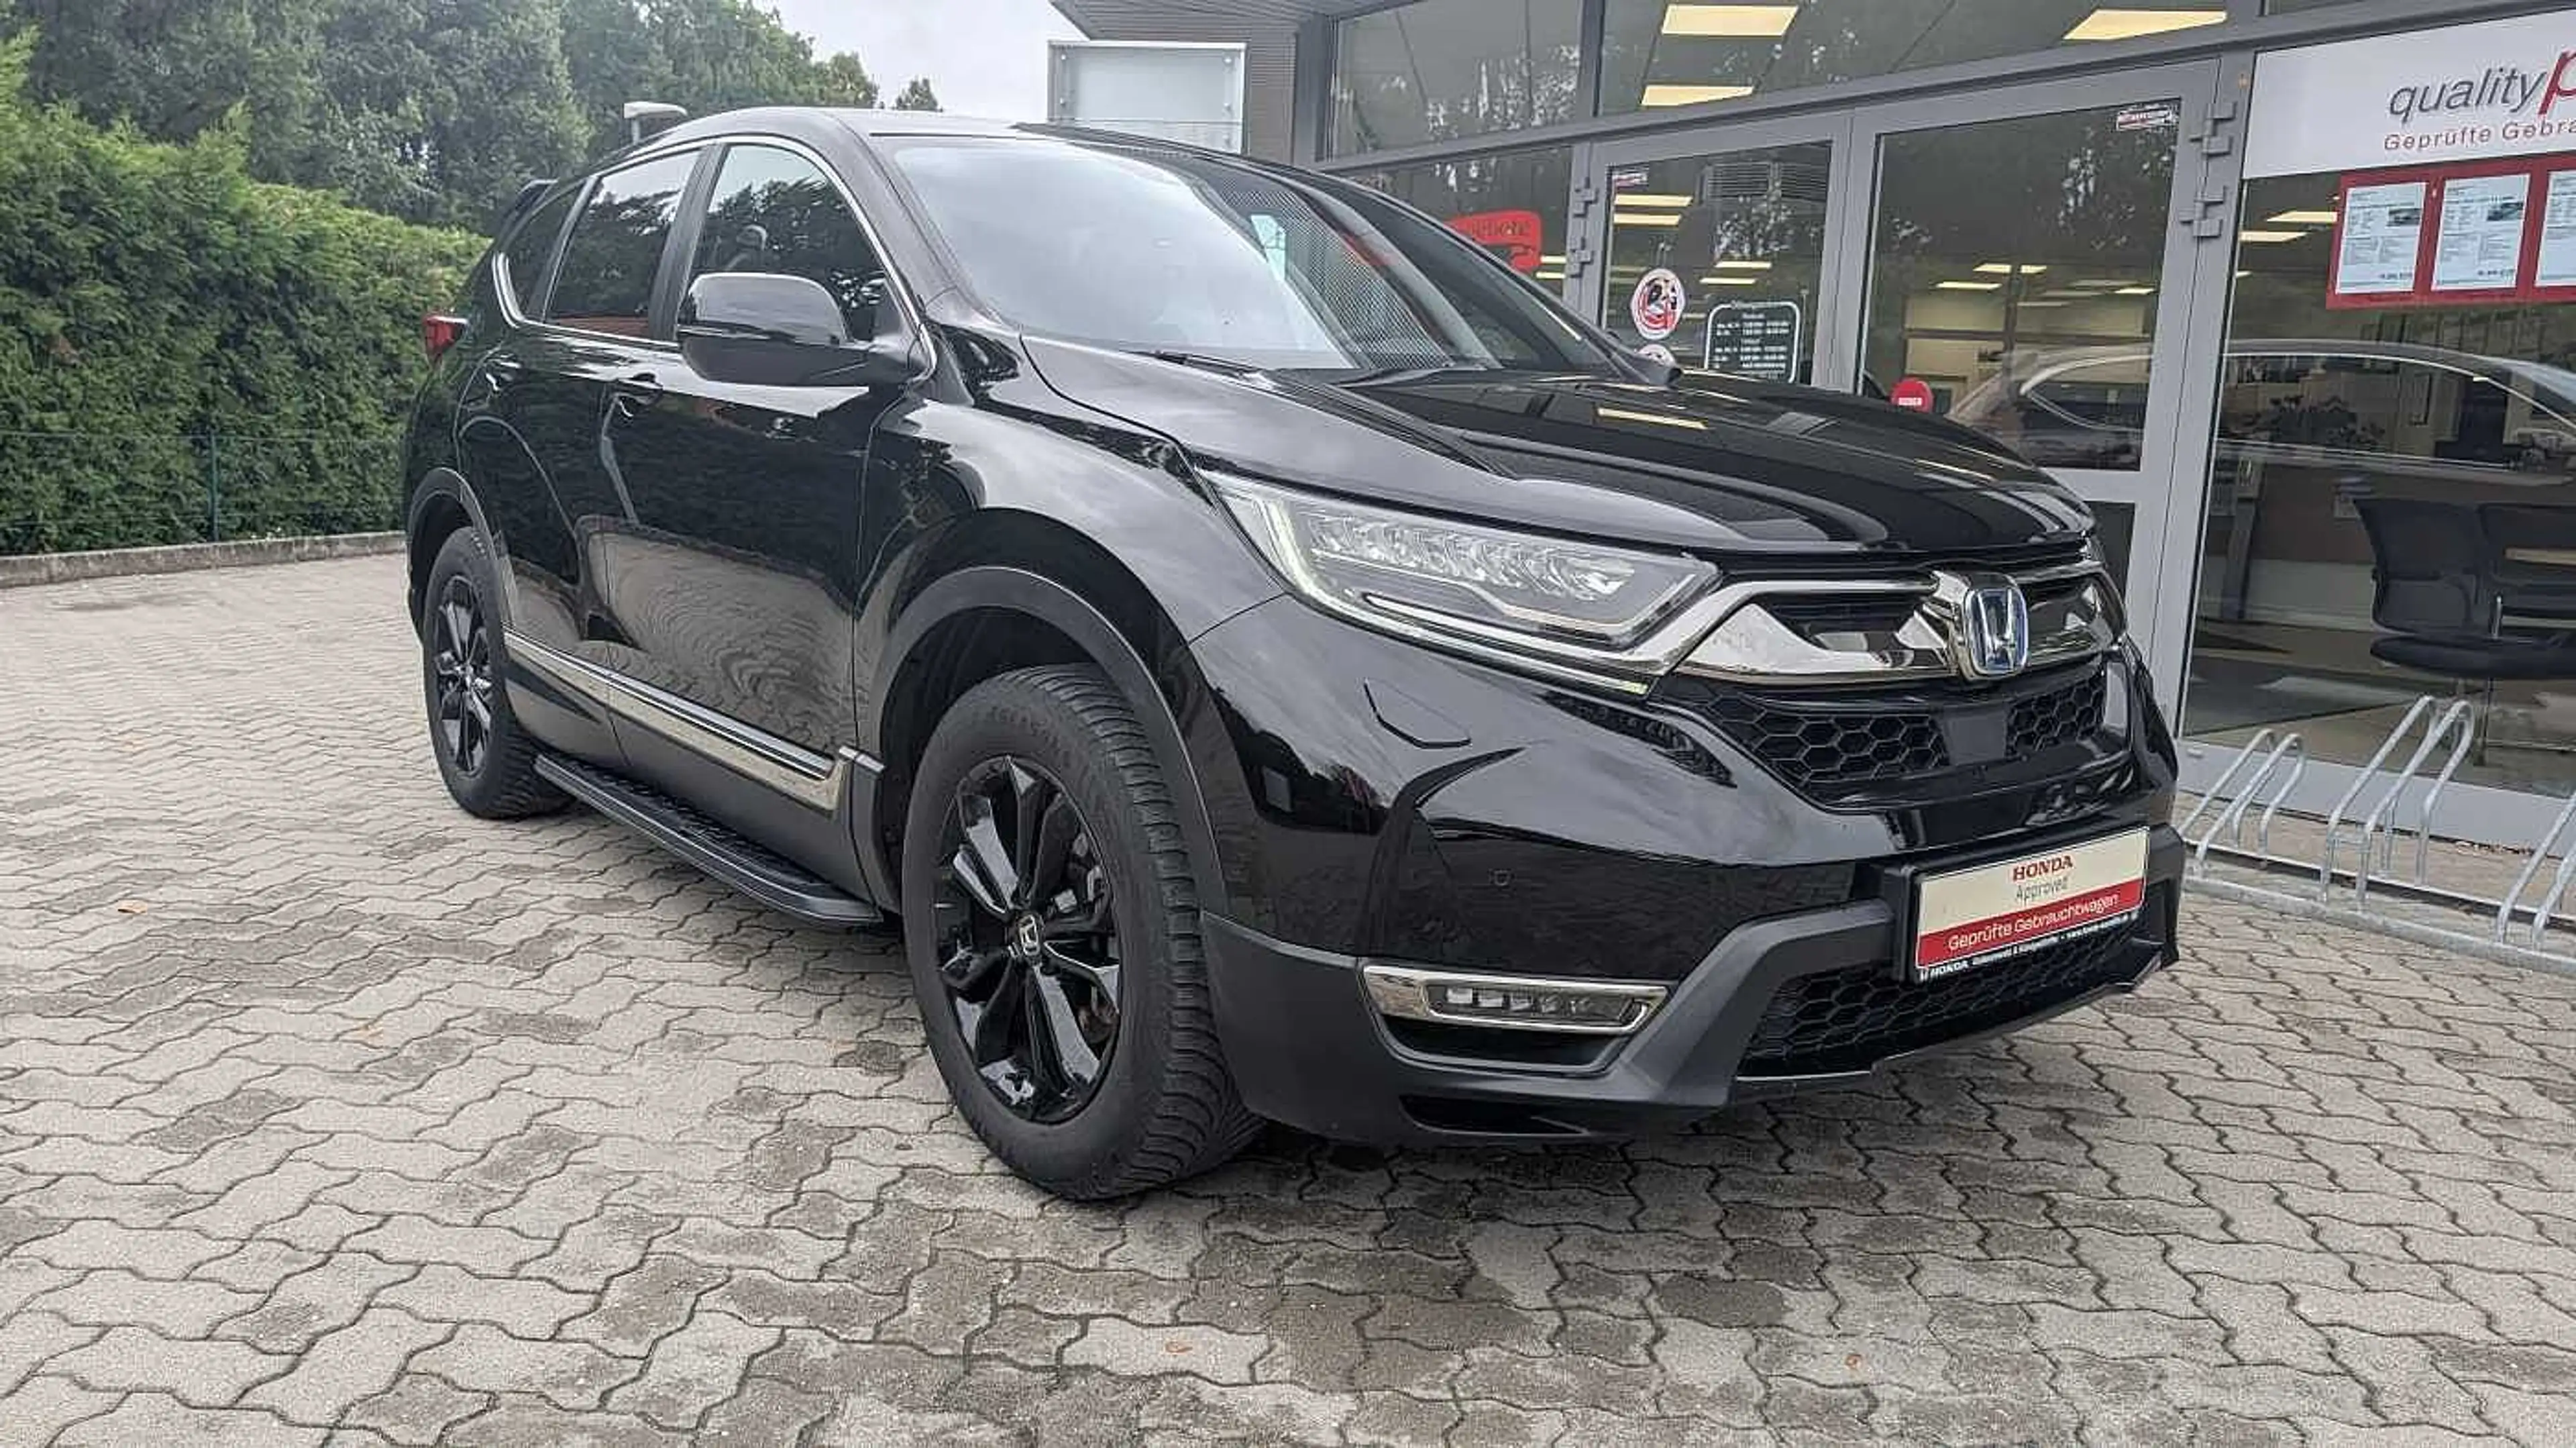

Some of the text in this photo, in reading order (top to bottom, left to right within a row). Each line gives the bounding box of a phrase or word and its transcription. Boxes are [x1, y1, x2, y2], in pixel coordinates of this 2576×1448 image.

[2384, 126, 2491, 150] Geprüfte
[2013, 856, 2074, 881] HONDA
[2016, 875, 2068, 902] Approved
[1948, 922, 2012, 950] Geprüfte
[2015, 894, 2119, 933] Gebrauchtwagen
